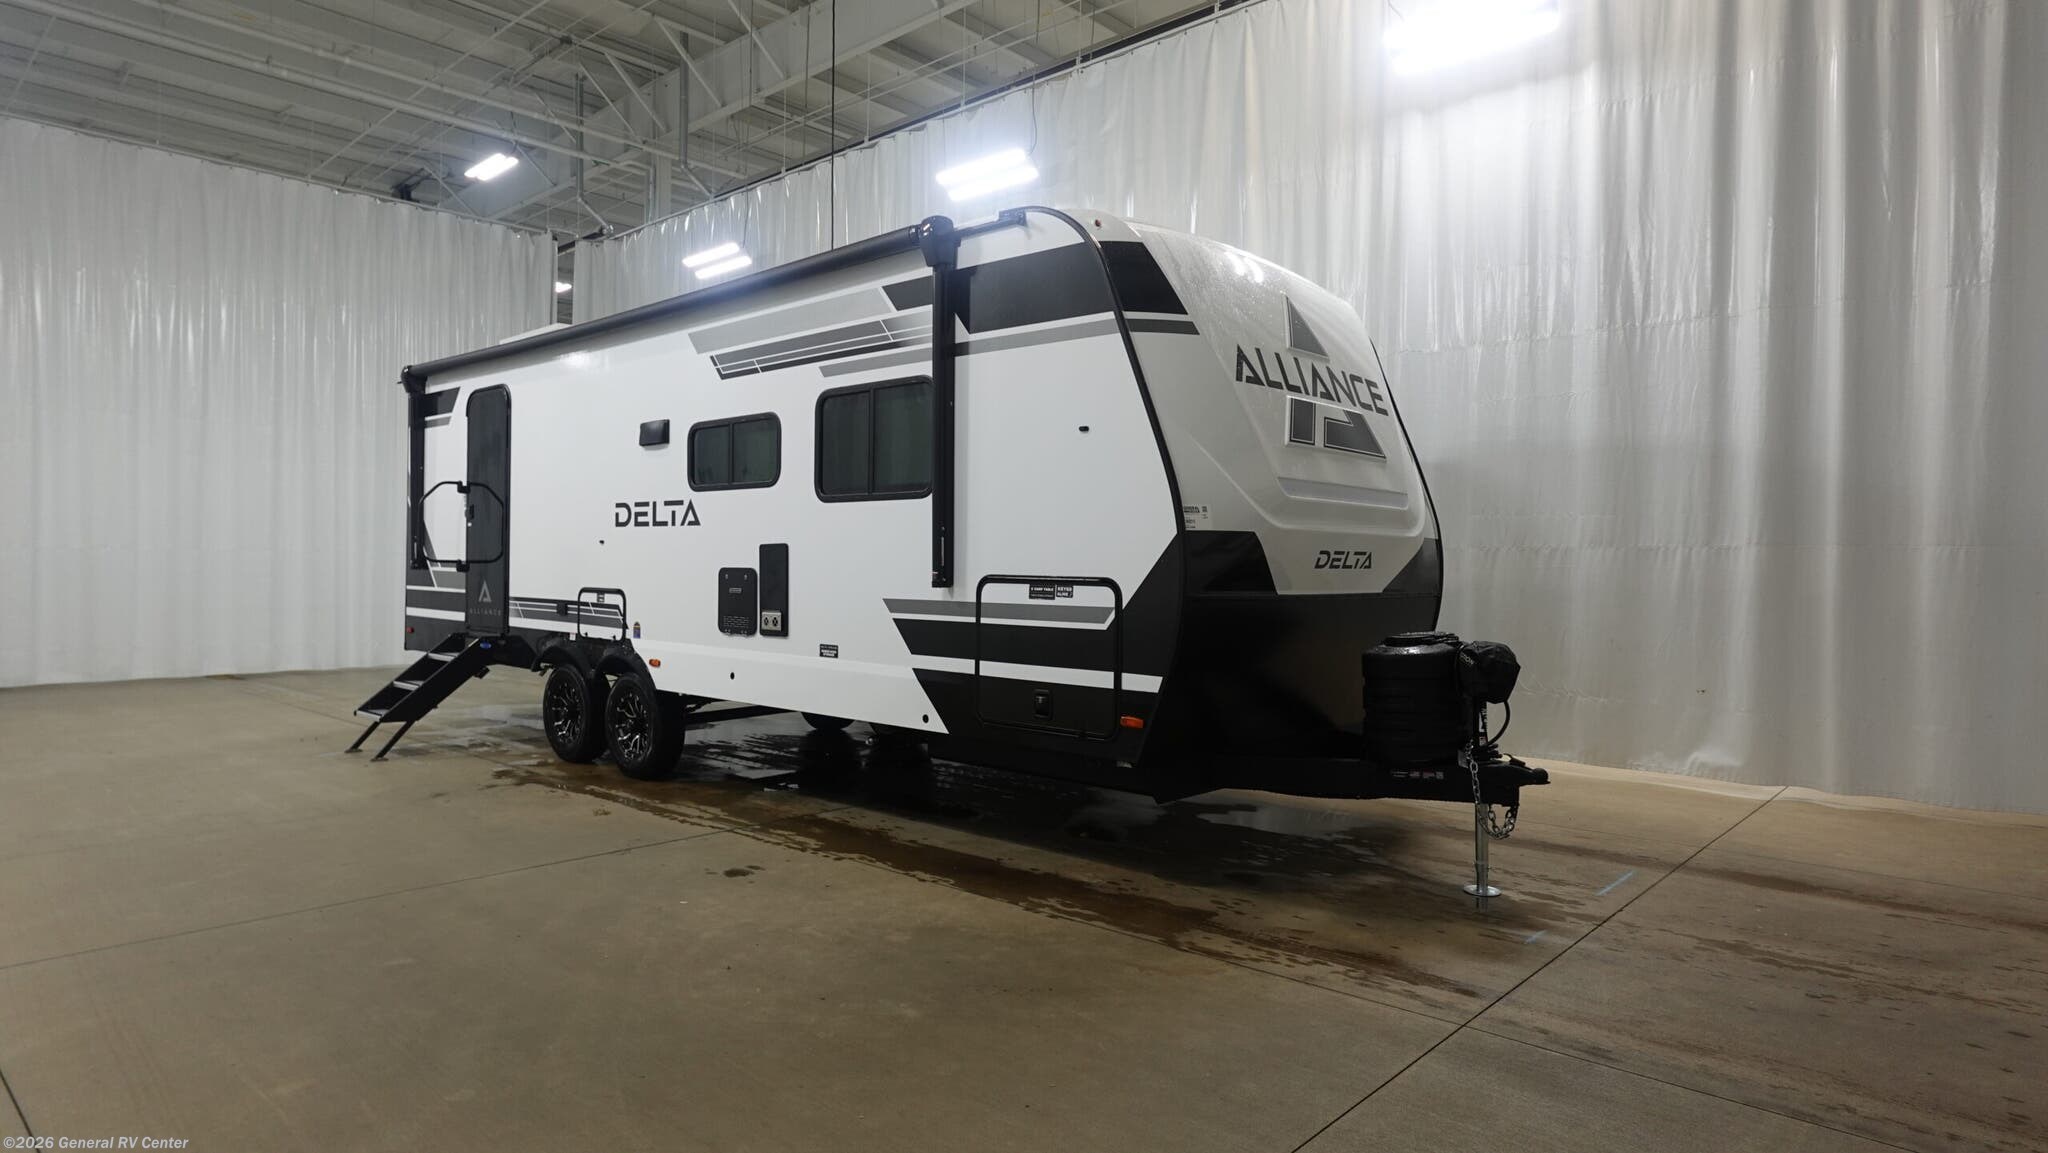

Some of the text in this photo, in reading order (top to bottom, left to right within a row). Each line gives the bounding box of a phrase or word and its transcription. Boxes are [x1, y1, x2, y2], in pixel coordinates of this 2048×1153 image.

[1236, 344, 1389, 416] ALLIANCE
[615, 498, 701, 527] DELTA
[1314, 550, 1372, 569] DELTA
